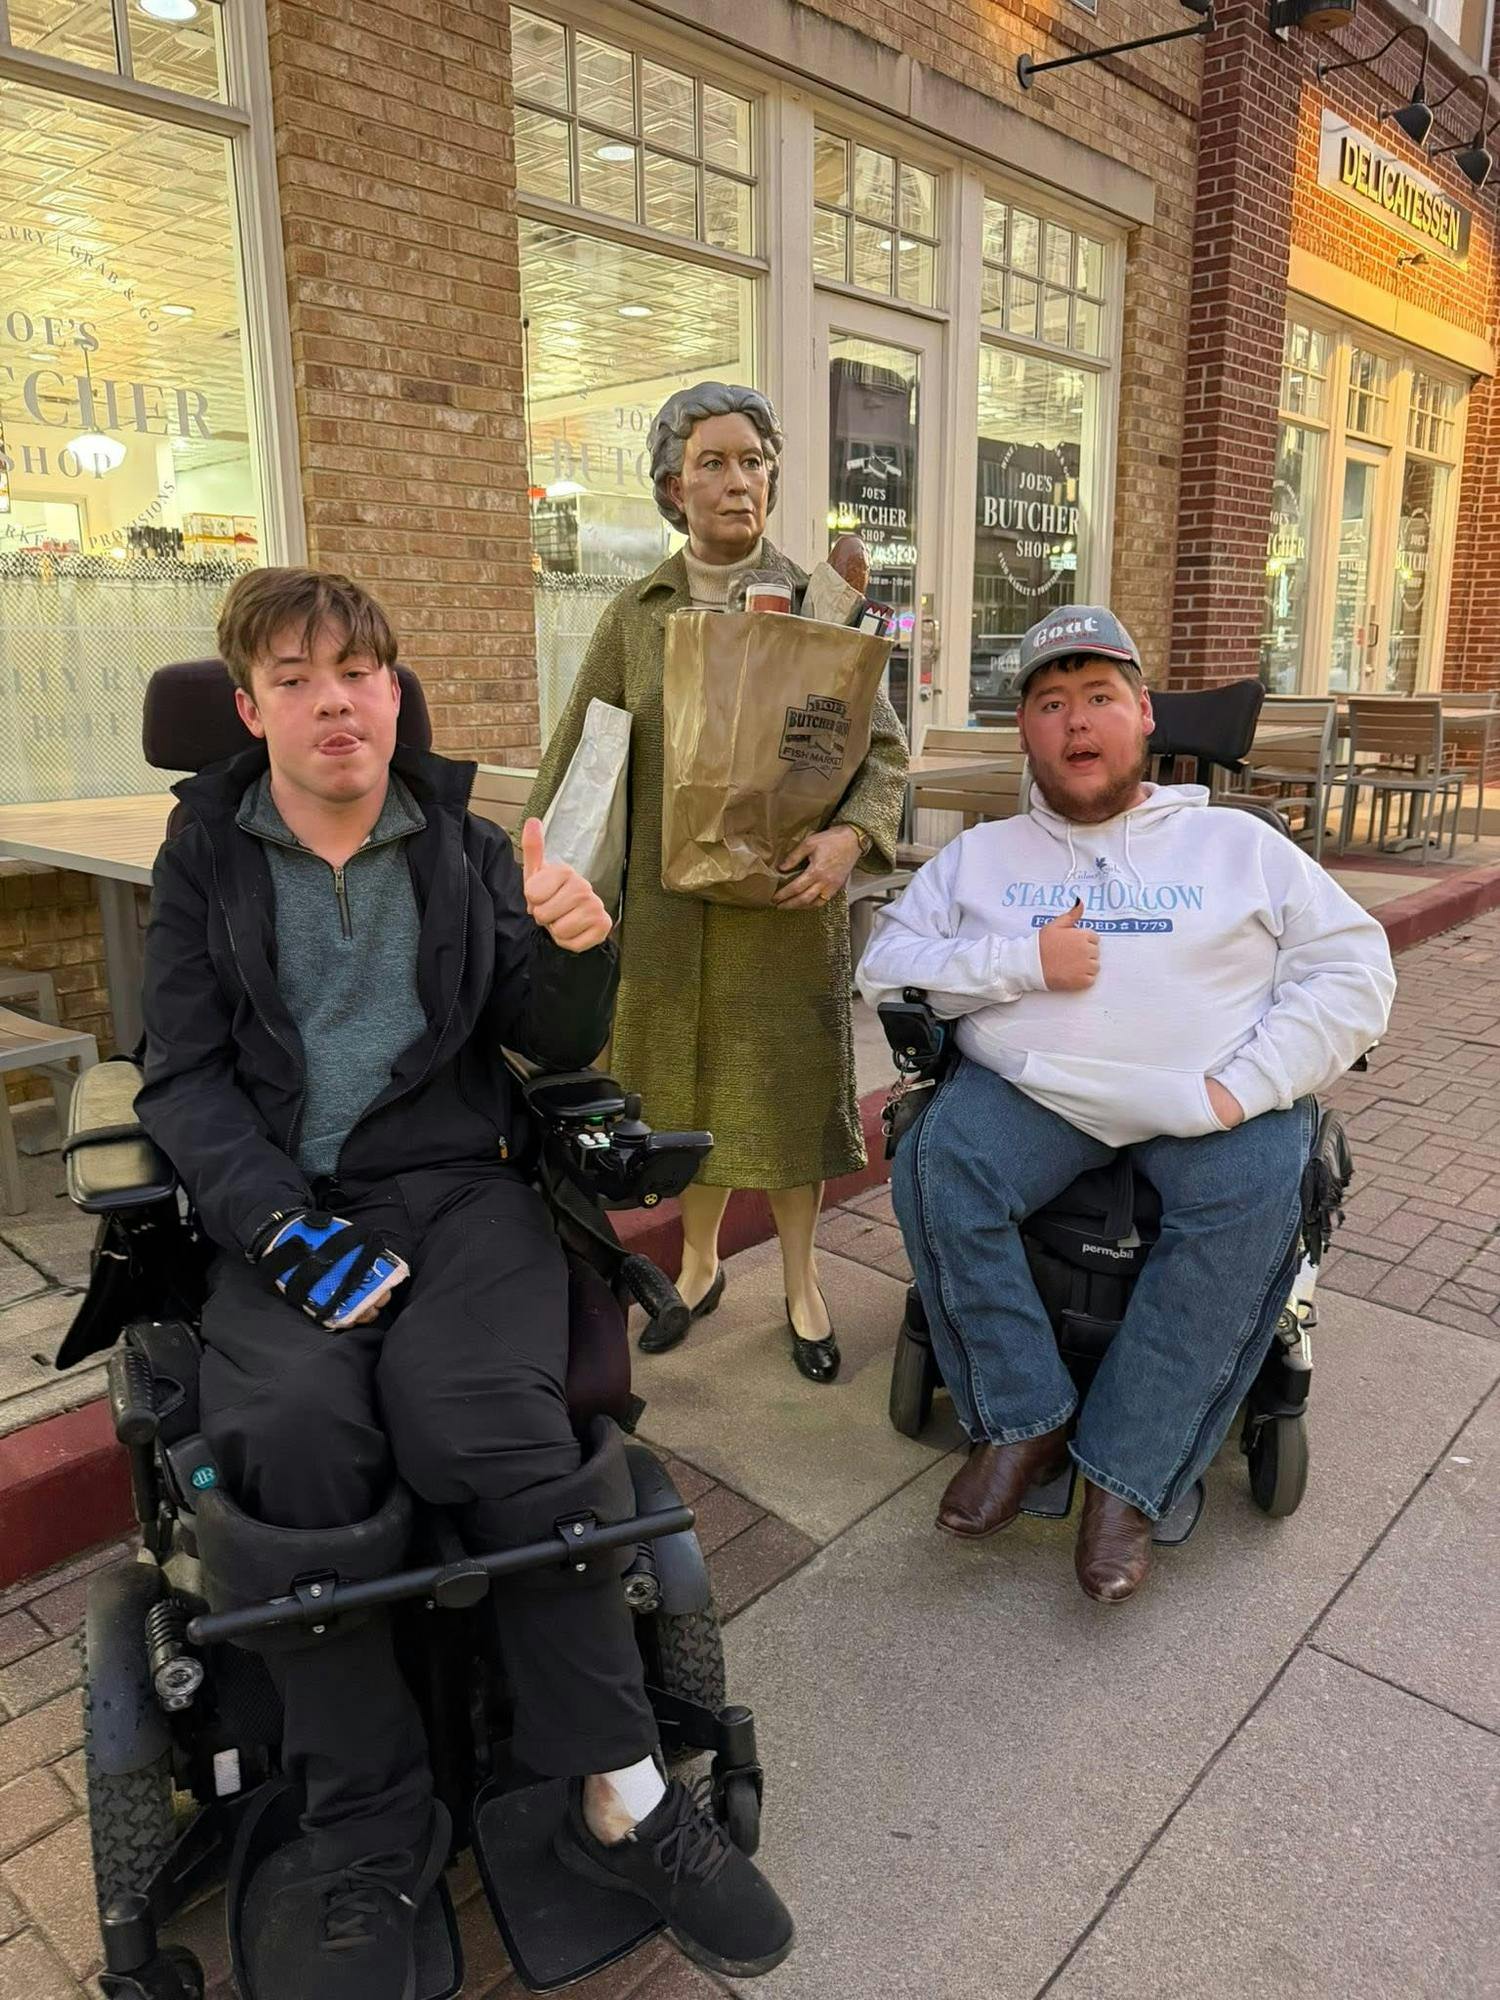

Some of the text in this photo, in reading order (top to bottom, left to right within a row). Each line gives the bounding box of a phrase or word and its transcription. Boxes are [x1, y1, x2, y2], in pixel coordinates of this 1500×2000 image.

[1340, 136, 1460, 251] DELICATESSEN
[70, 246, 118, 283] GRAB
[139, 307, 159, 332] GO
[0, 365, 213, 440] CHER
[615, 407, 654, 433] JO
[1019, 472, 1052, 493] JOE'S
[88, 480, 175, 549] PROVISIONS
[838, 502, 907, 527] BUTCHER
[983, 495, 1079, 535] BUTCHER
[861, 529, 885, 542] SHOP
[1016, 540, 1051, 558] SHOP
[1033, 617, 1099, 647] Goat
[788, 710, 835, 731] BUTCHER
[783, 746, 808, 760] FISH
[1002, 879, 1204, 912] STARS HOLLOW
[1134, 921, 1168, 931] 1779
[1082, 1243, 1134, 1259] permobil
